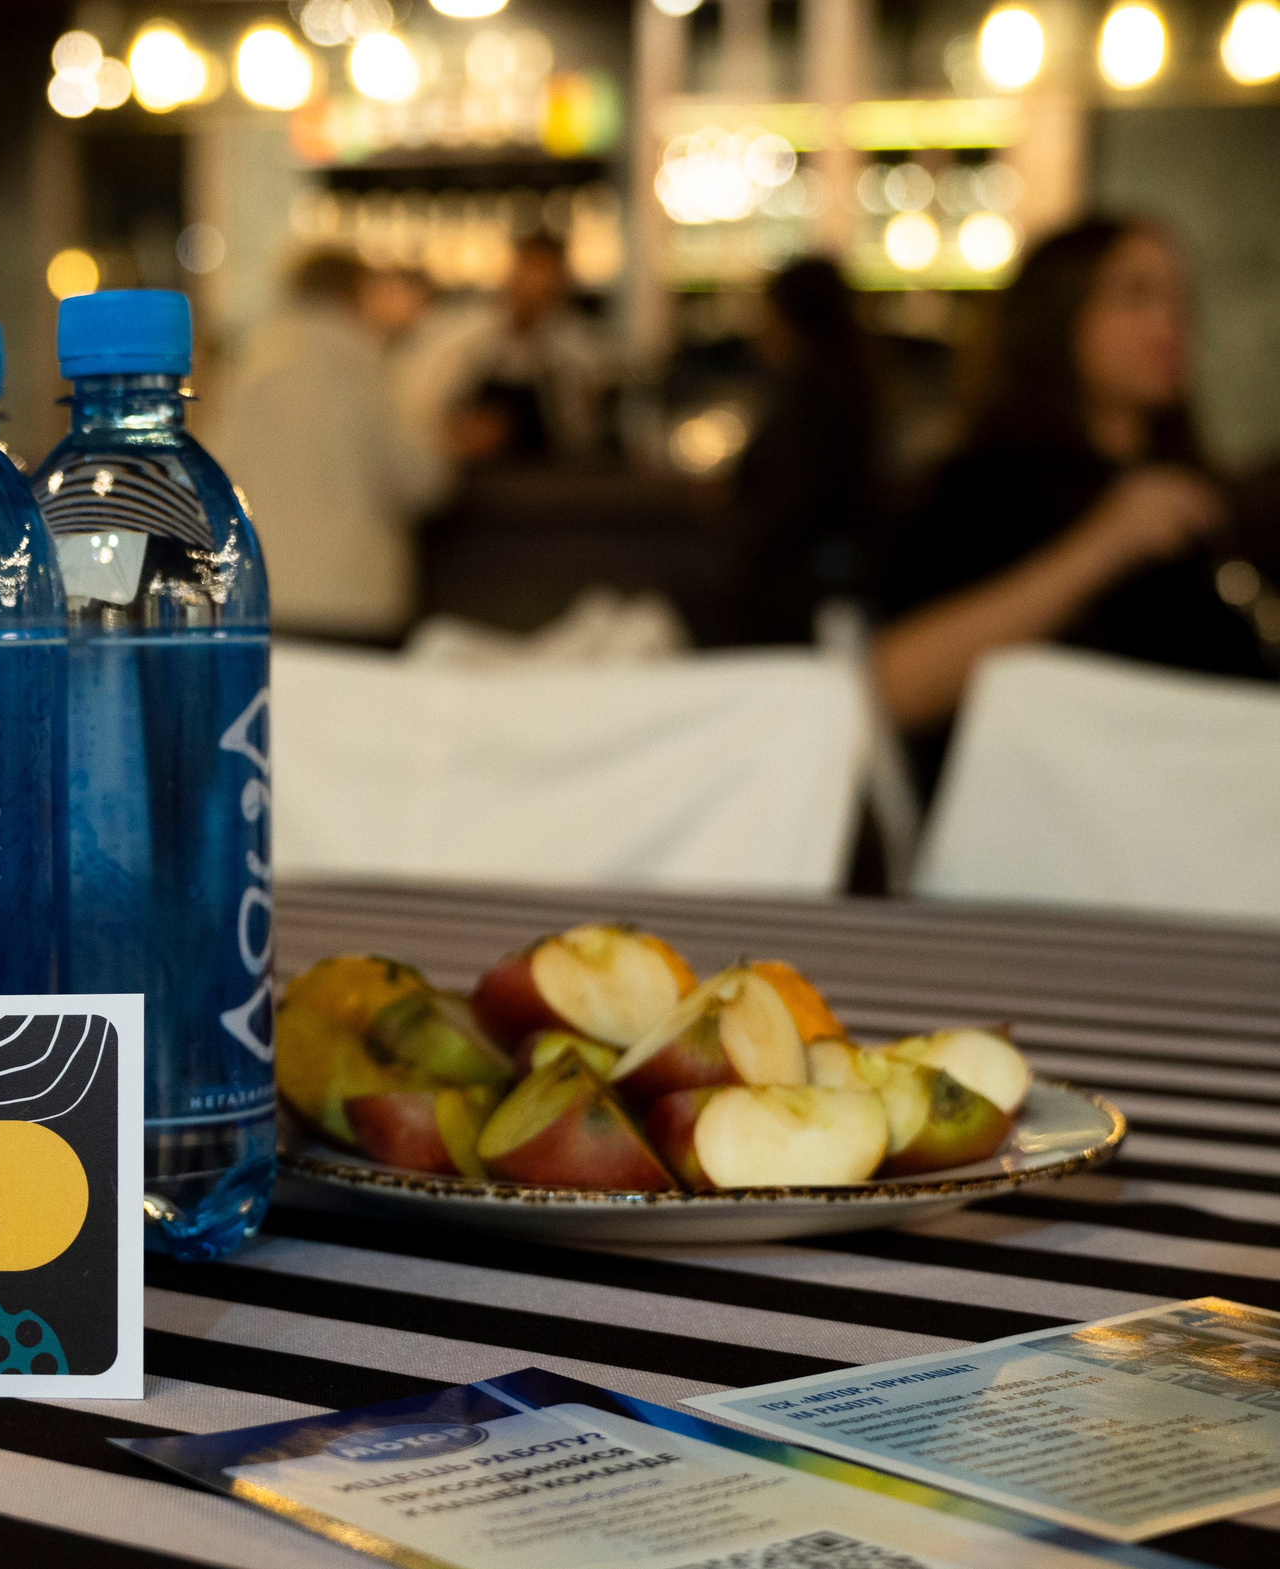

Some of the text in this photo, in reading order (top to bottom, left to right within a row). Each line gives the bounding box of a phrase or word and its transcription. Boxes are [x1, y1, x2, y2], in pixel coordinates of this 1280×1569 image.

[758, 1394, 801, 1412] ТСК
[870, 1363, 981, 1390] ПРИГЛАШАЕТ
[786, 1395, 890, 1421] НА РАБОТУ!
[469, 1430, 606, 1468] РАБОТУ?
[535, 1451, 682, 1493] КОМАНДЕ
